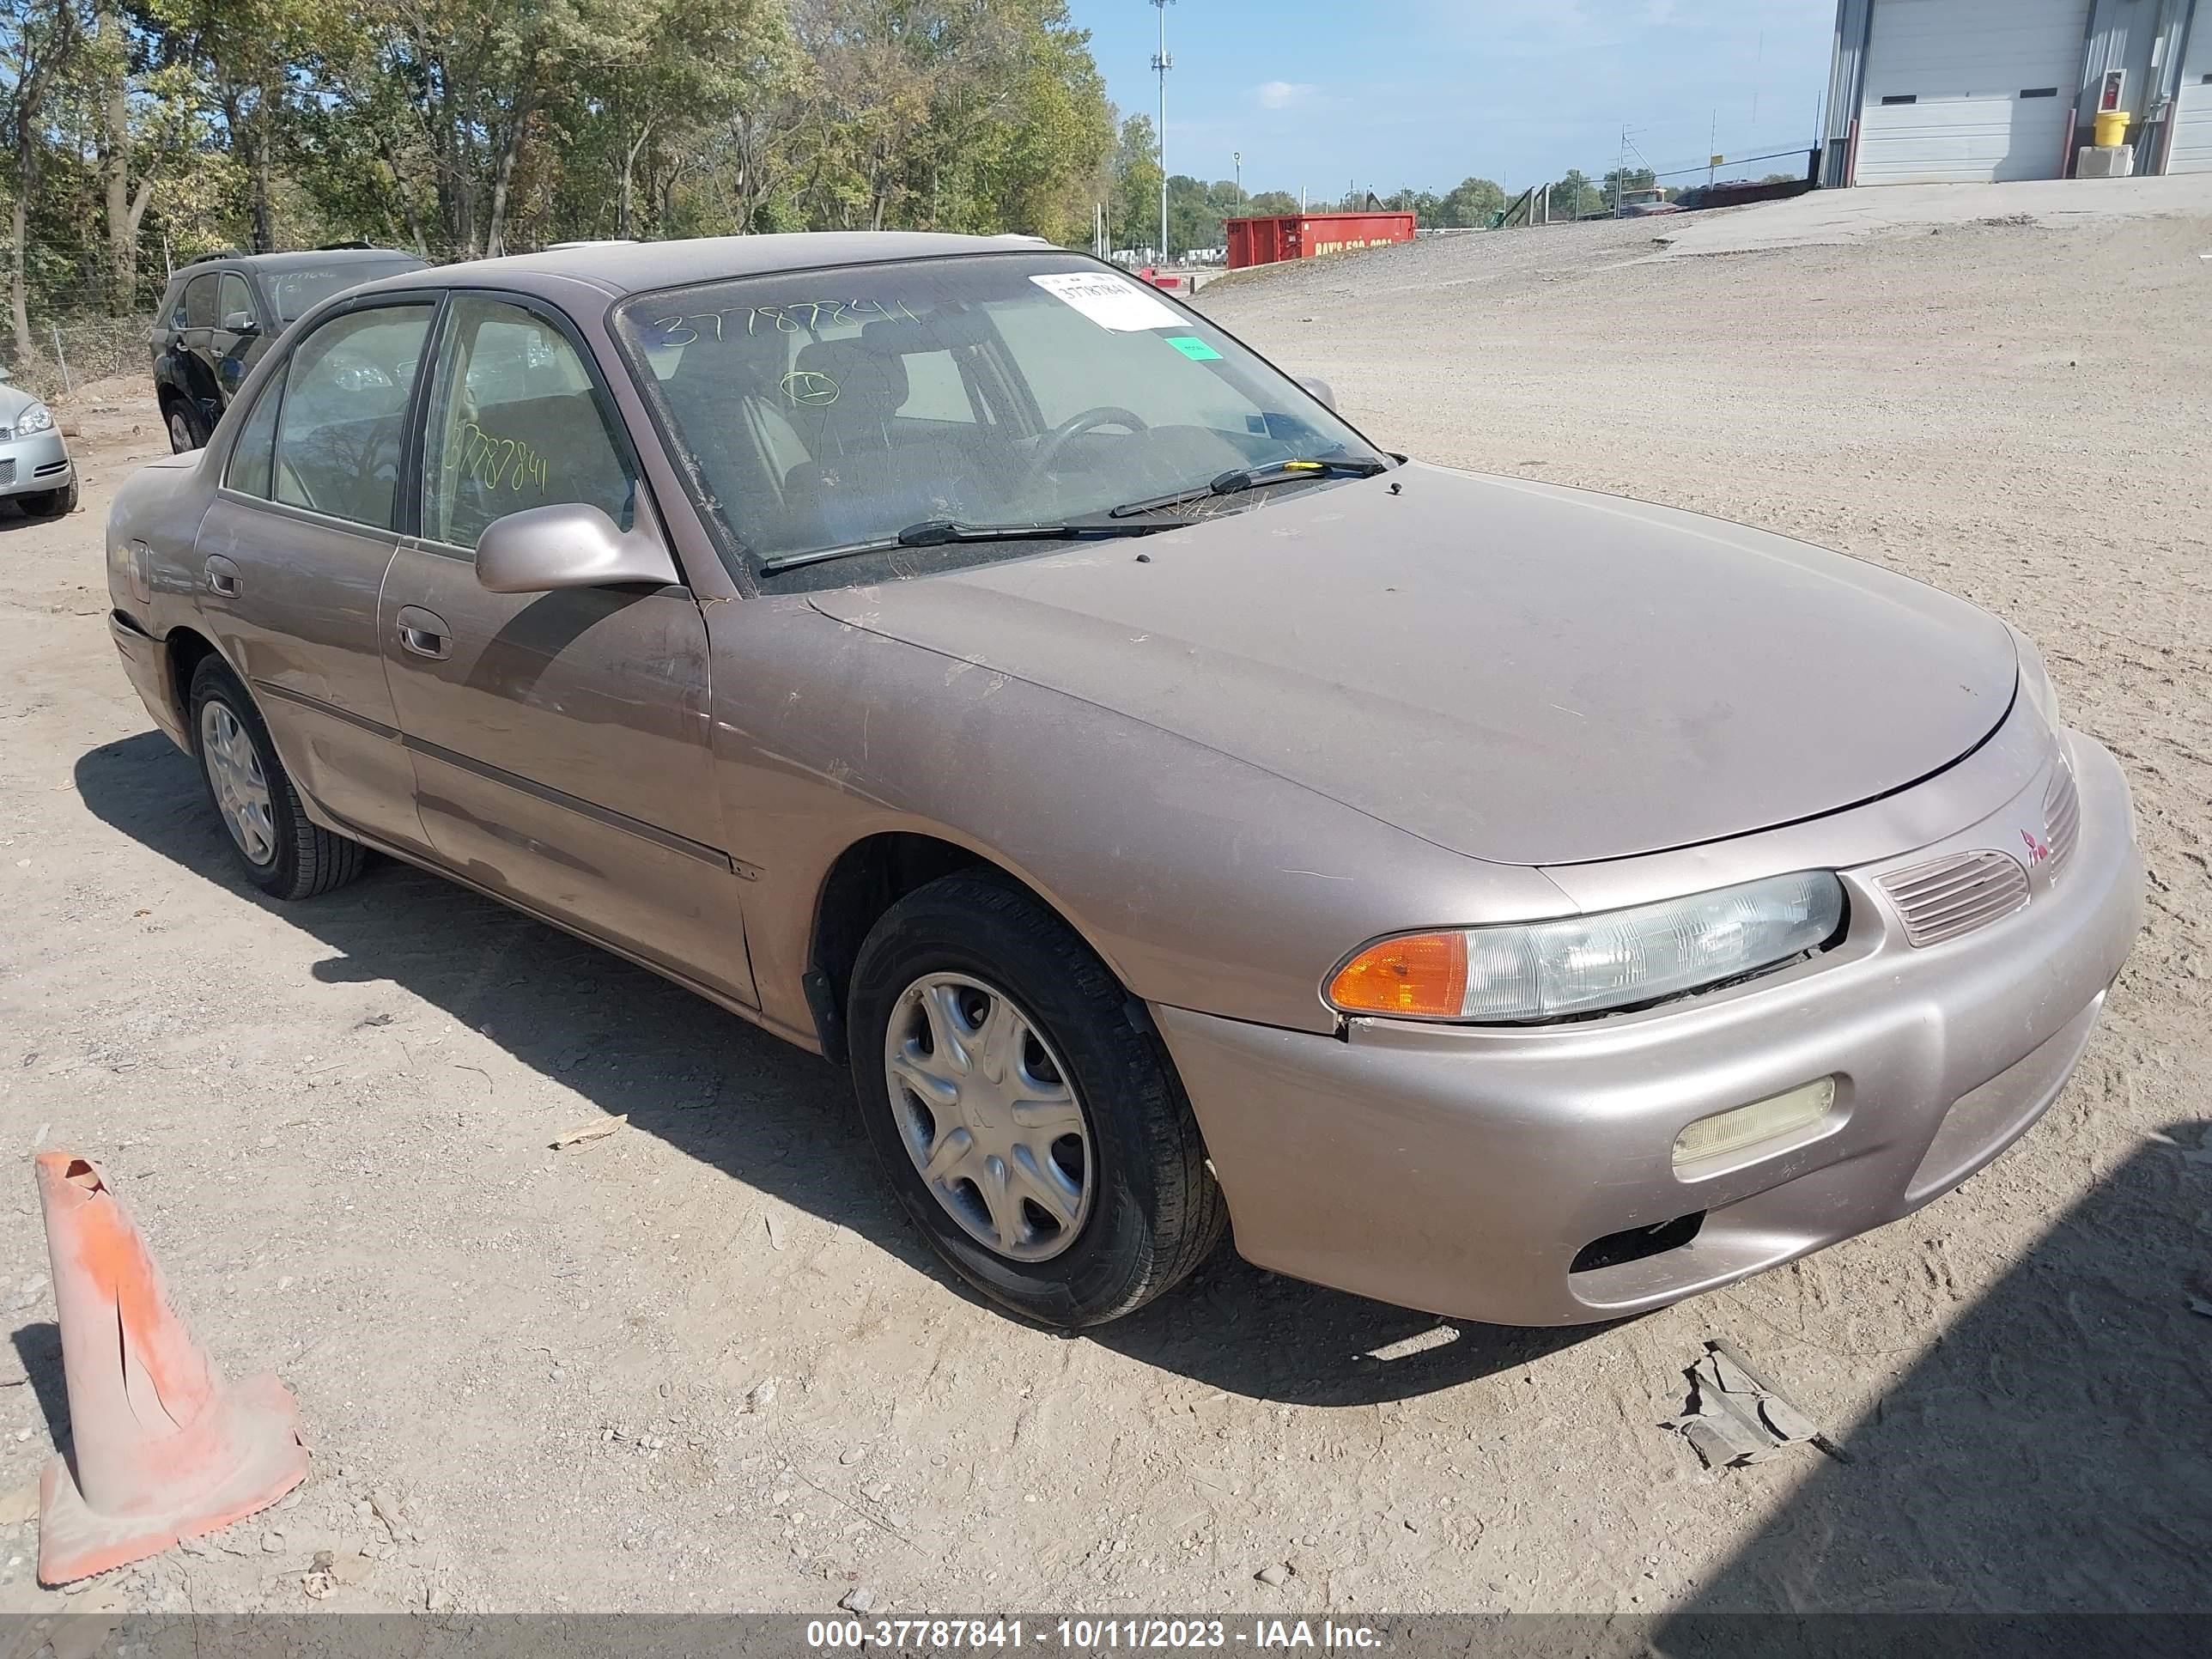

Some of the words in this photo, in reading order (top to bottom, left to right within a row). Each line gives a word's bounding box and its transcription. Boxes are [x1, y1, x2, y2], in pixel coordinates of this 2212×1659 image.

[1059, 284, 1132, 300] 37787841
[653, 298, 922, 348] 37787841
[444, 422, 547, 495] 37787841
